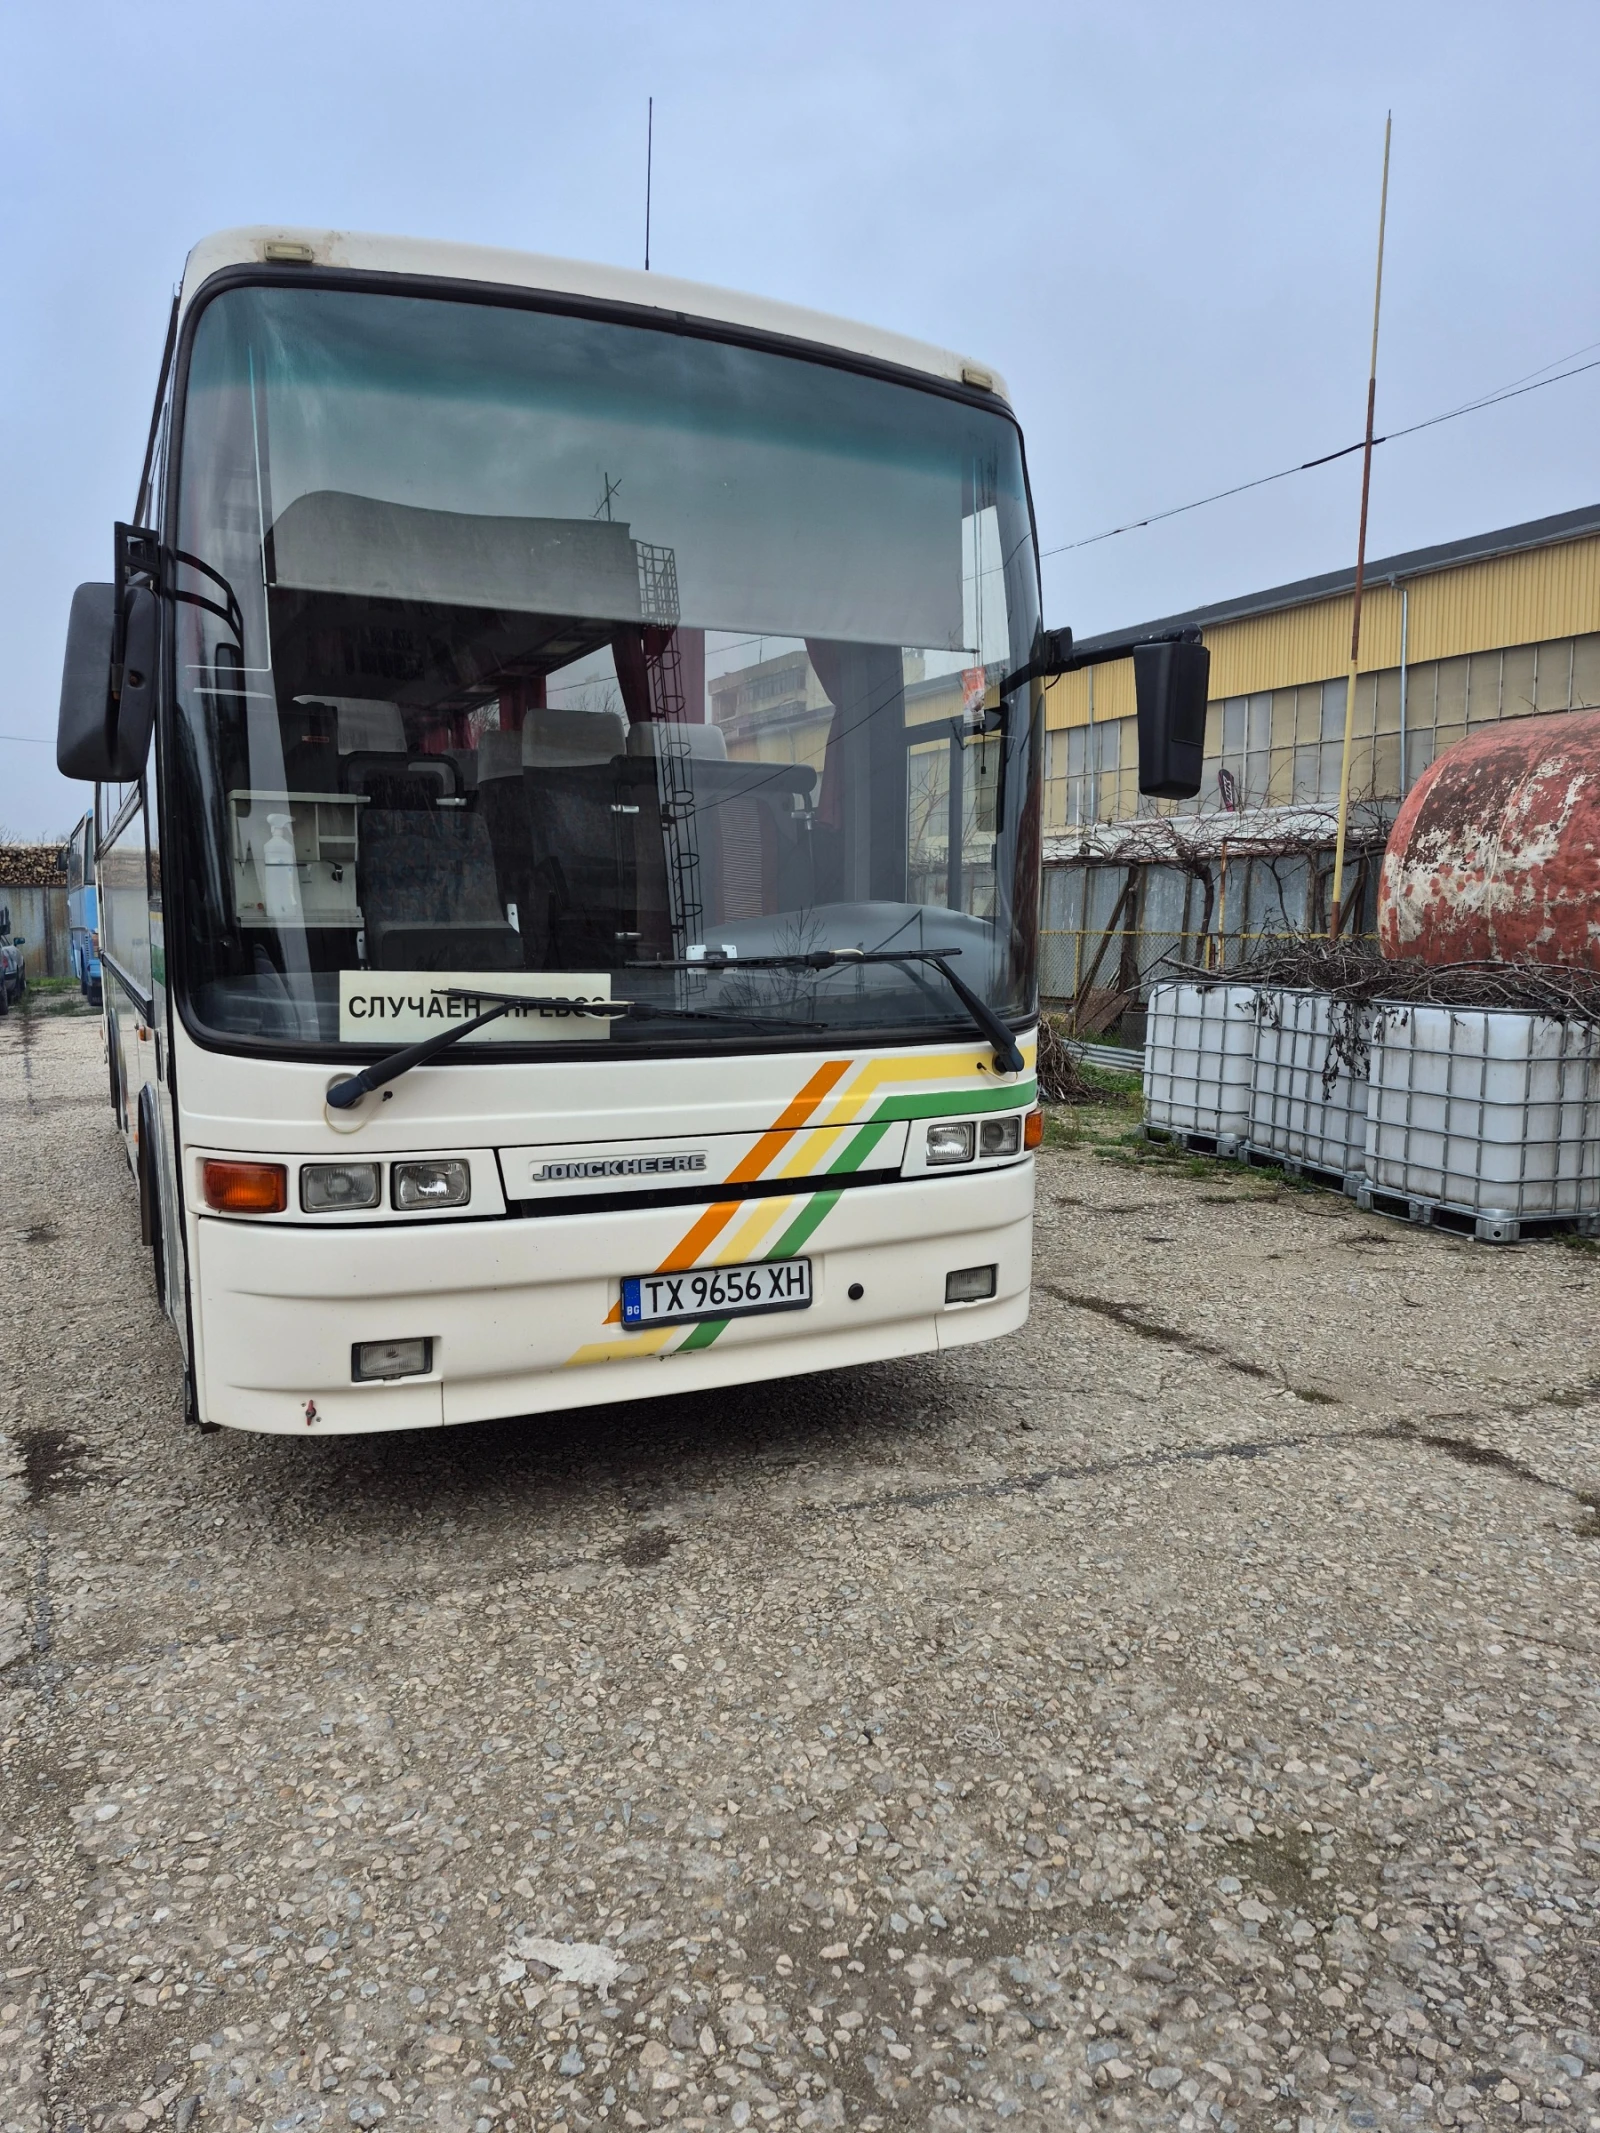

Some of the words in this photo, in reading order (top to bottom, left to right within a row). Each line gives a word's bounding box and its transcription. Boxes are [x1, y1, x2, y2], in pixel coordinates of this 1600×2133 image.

[348, 995, 481, 1018] СЛУЧАЕН
[504, 996, 606, 1018] ПЕВО
[532, 1154, 707, 1182] JONCKHEERE
[645, 1279, 684, 1313] TX
[691, 1271, 762, 1308] 9656
[768, 1265, 805, 1299] XH
[626, 1305, 640, 1316] BG
